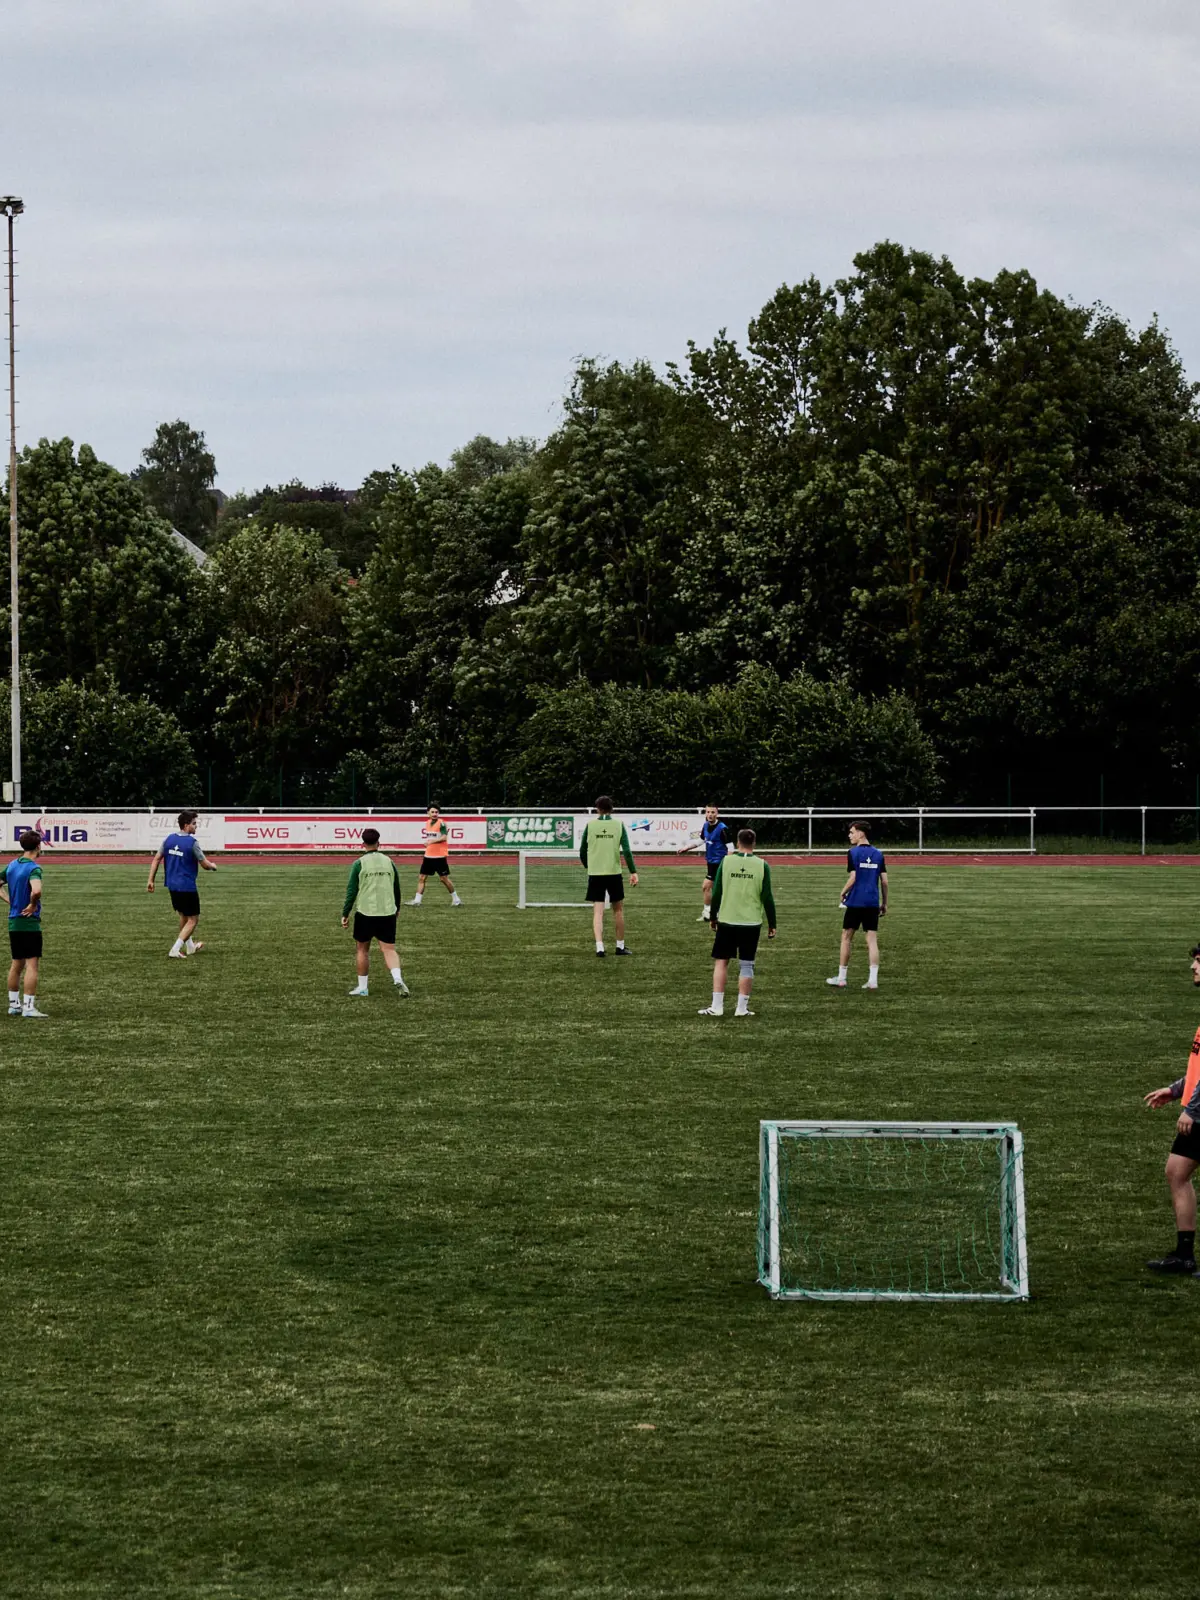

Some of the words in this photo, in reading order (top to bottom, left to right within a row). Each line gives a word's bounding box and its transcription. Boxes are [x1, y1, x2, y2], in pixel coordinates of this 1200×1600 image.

[507, 817, 553, 831] GEILE
[655, 821, 688, 831] JUNG
[247, 828, 289, 838] SWG
[334, 828, 362, 838] SW
[421, 828, 464, 839] SG
[504, 831, 555, 843] BANDE
